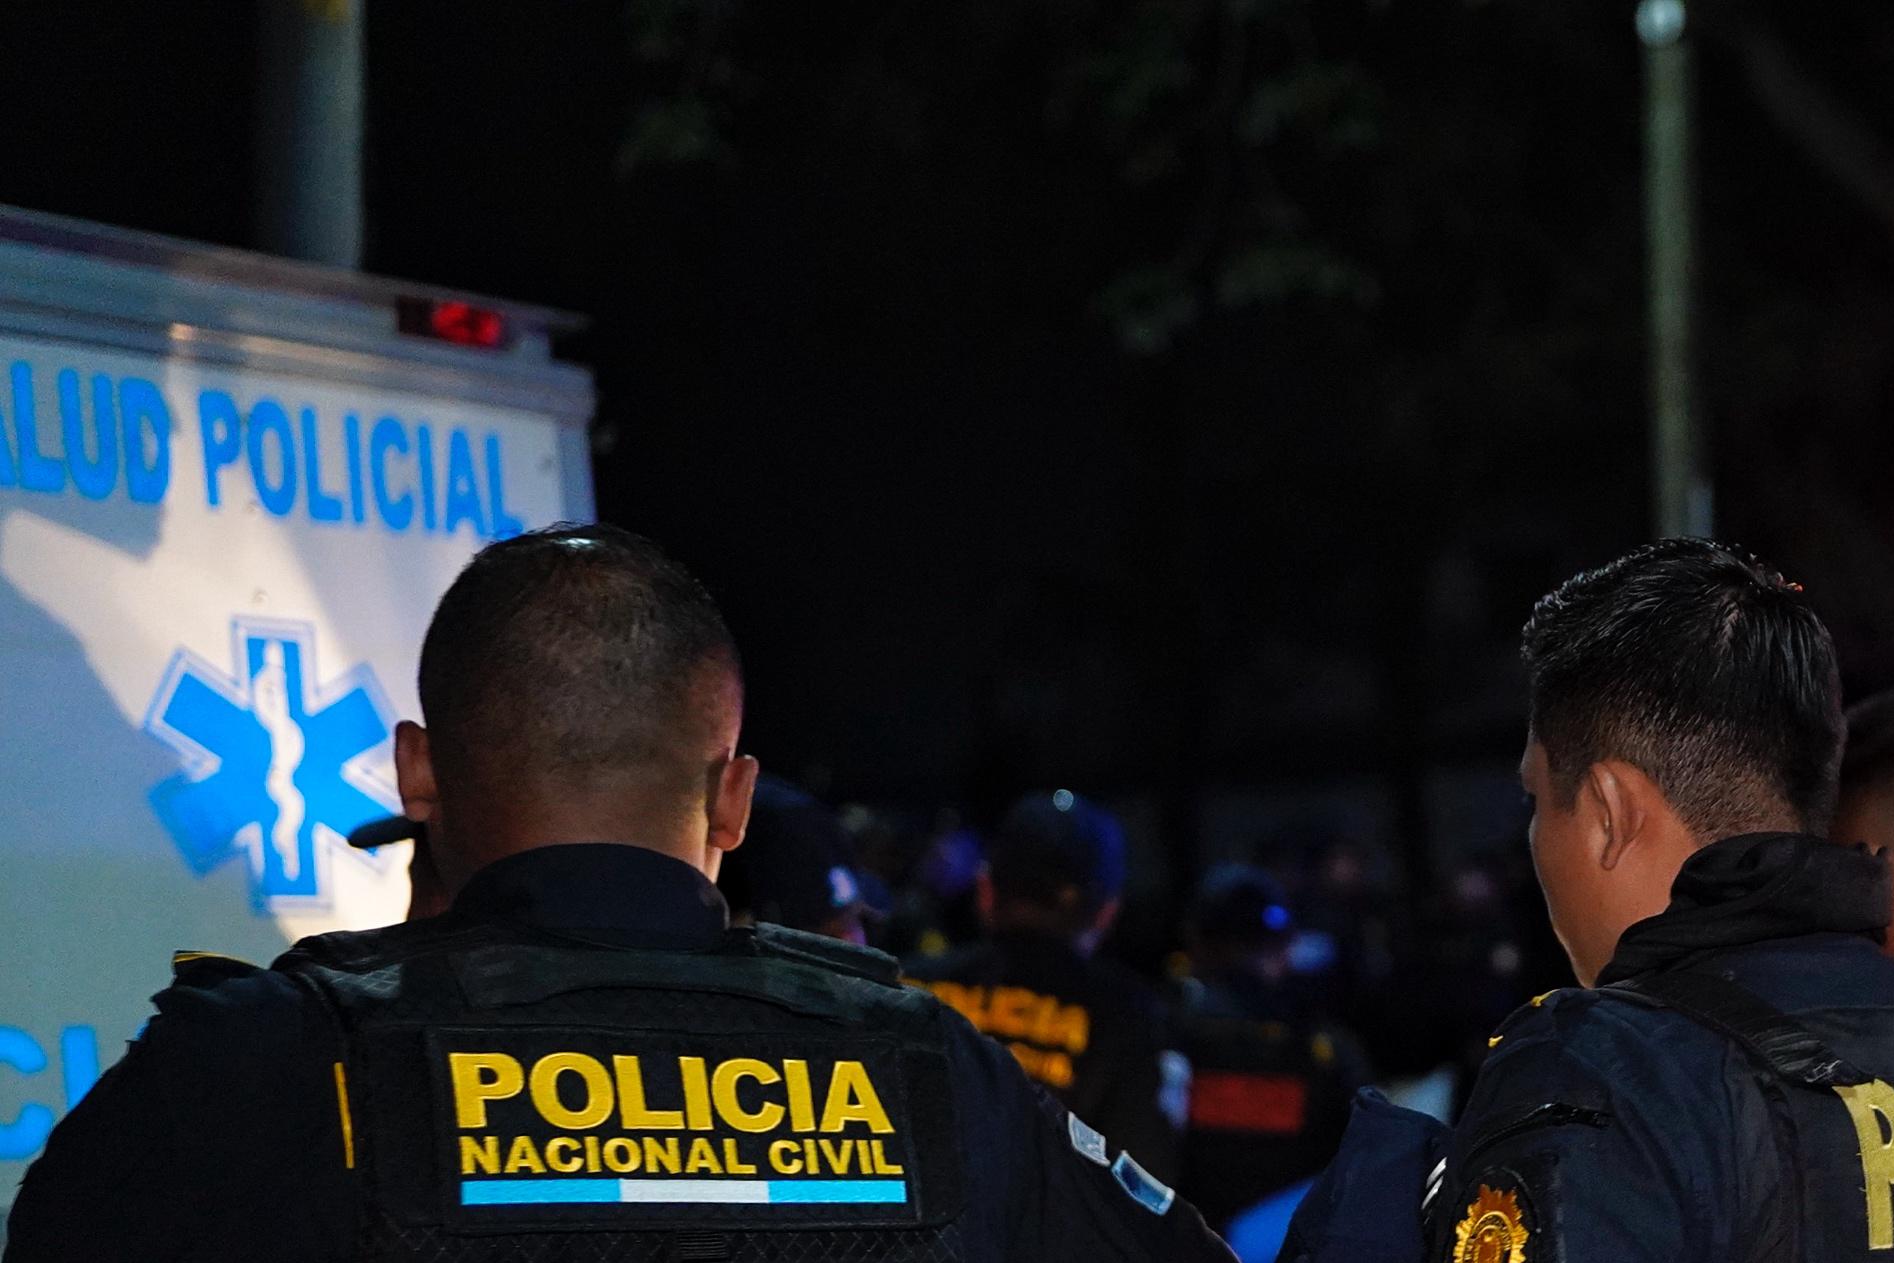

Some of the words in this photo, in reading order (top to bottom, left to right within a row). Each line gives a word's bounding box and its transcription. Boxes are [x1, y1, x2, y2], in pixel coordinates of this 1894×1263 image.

[0, 360, 171, 504] LUD
[198, 388, 525, 541] POLICIAL
[449, 1052, 895, 1134] POLICIA
[458, 1135, 758, 1176] NACIONAL
[768, 1138, 905, 1176] CIVIL
